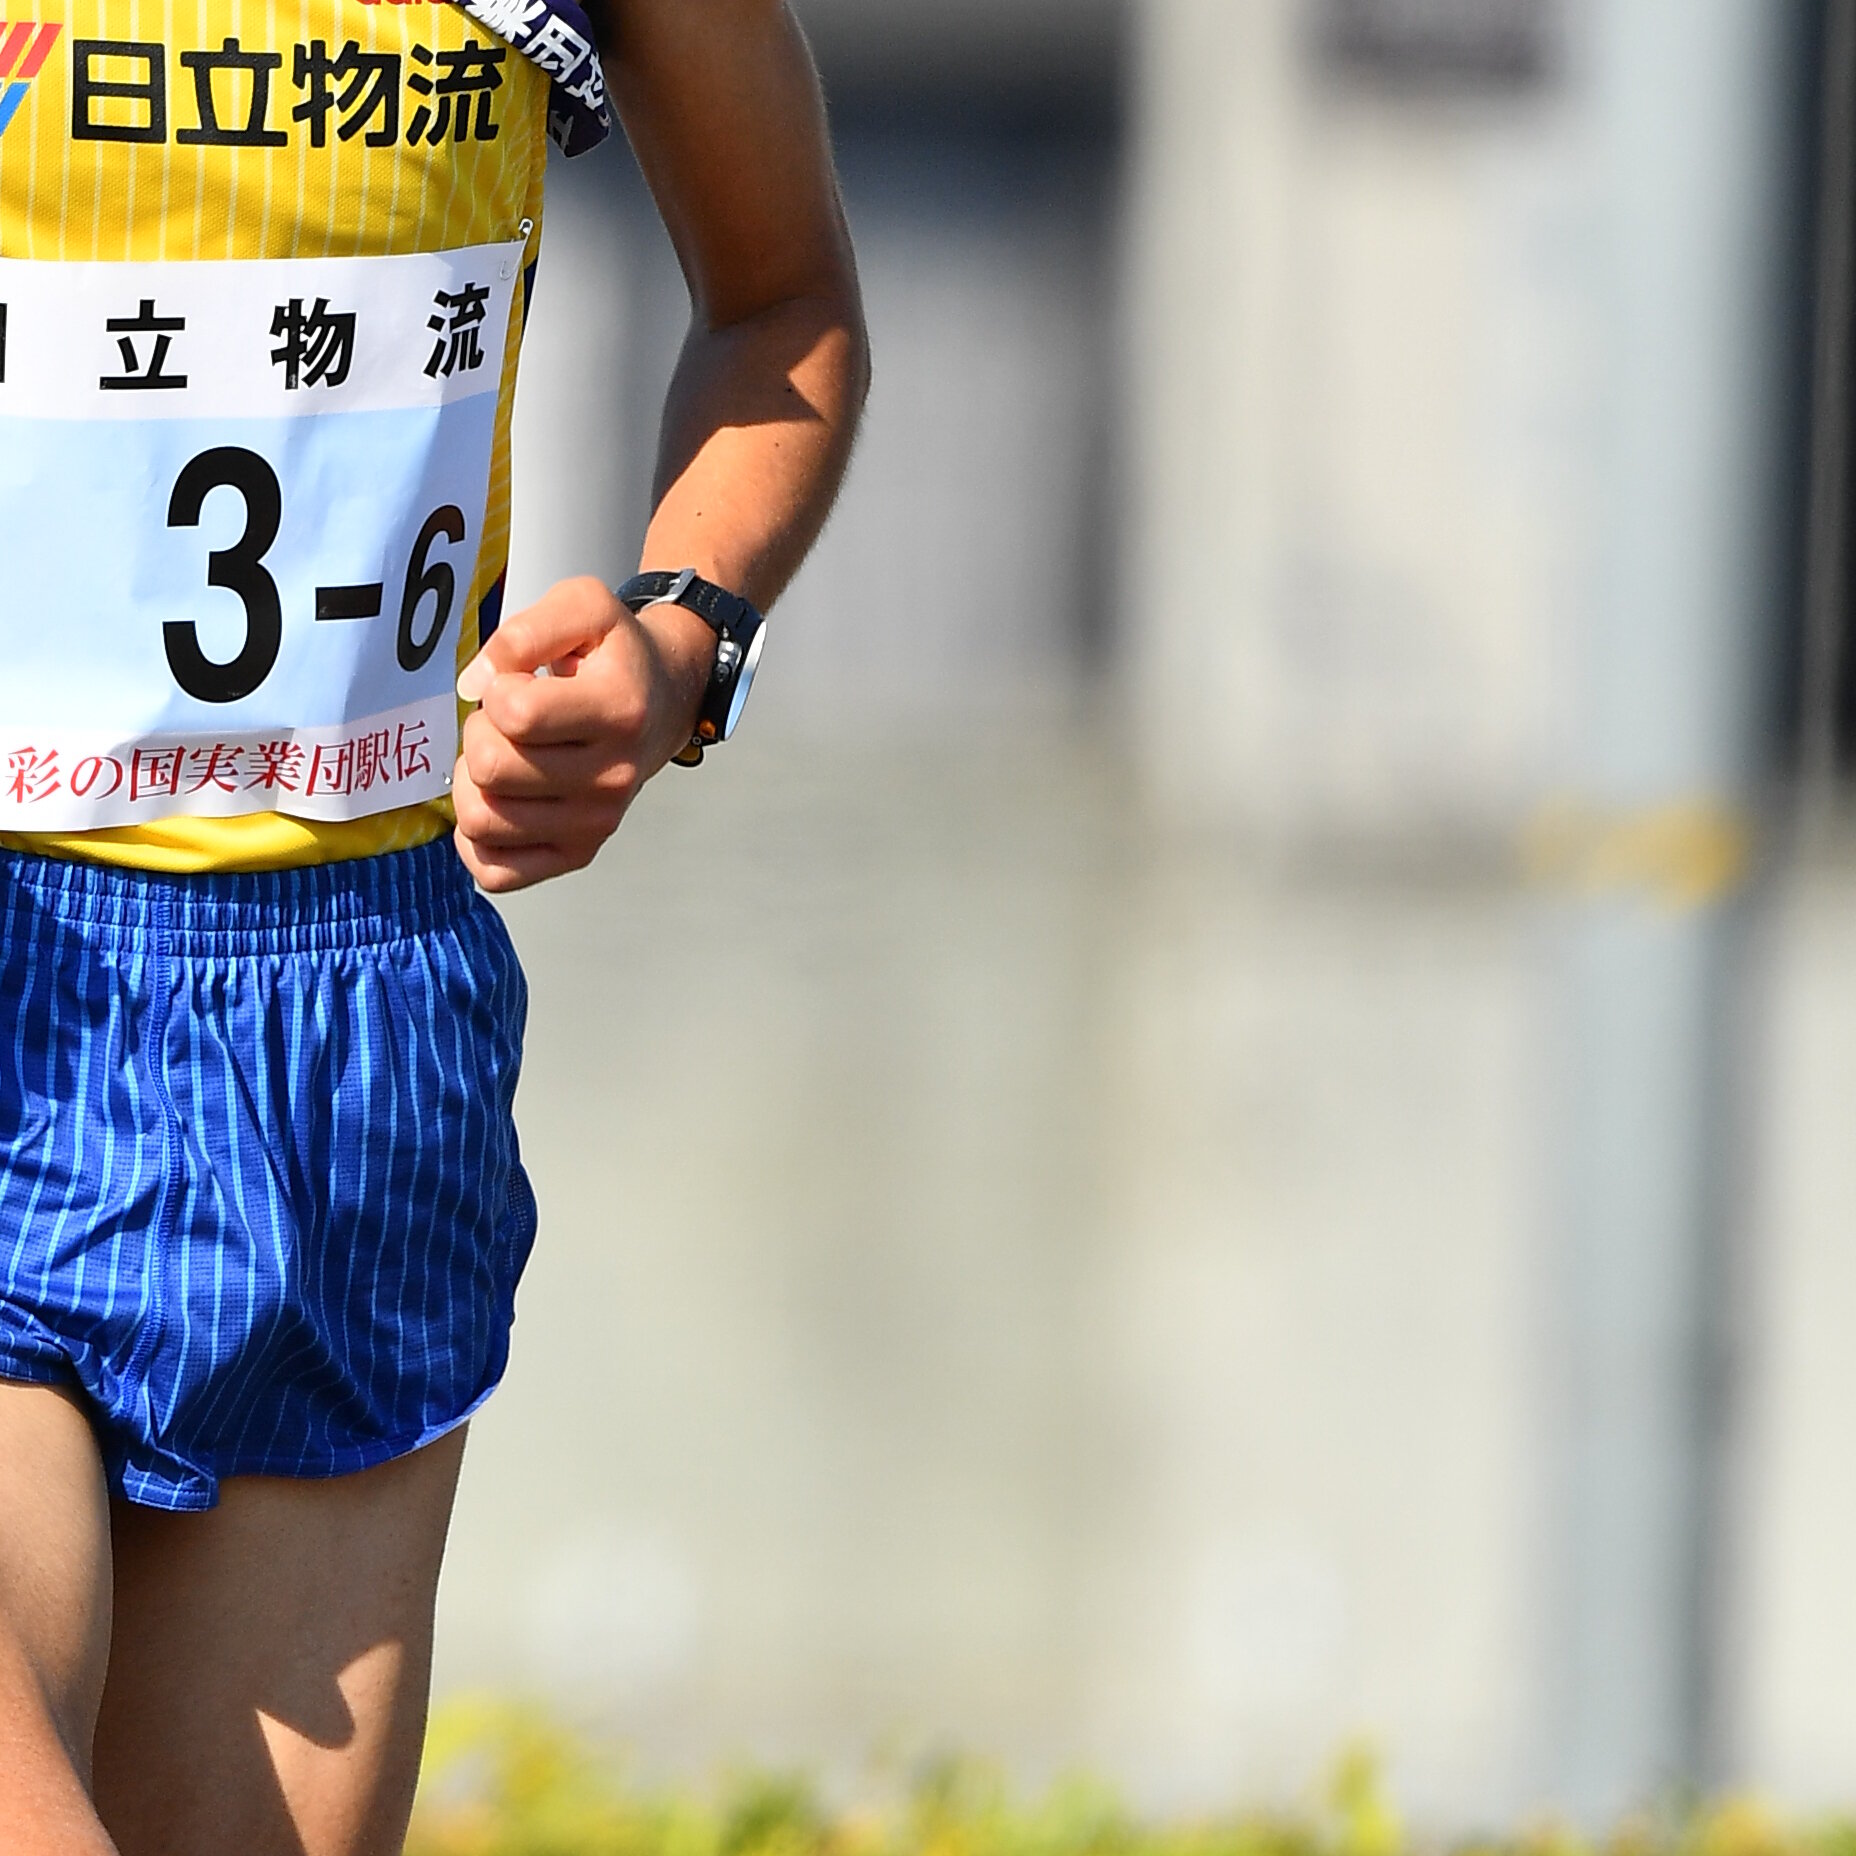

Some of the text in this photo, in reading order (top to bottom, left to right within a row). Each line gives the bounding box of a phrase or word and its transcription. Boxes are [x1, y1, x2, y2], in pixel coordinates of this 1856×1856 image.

[70, 37, 508, 149] 日立物流
[162, 445, 466, 704] 3-6
